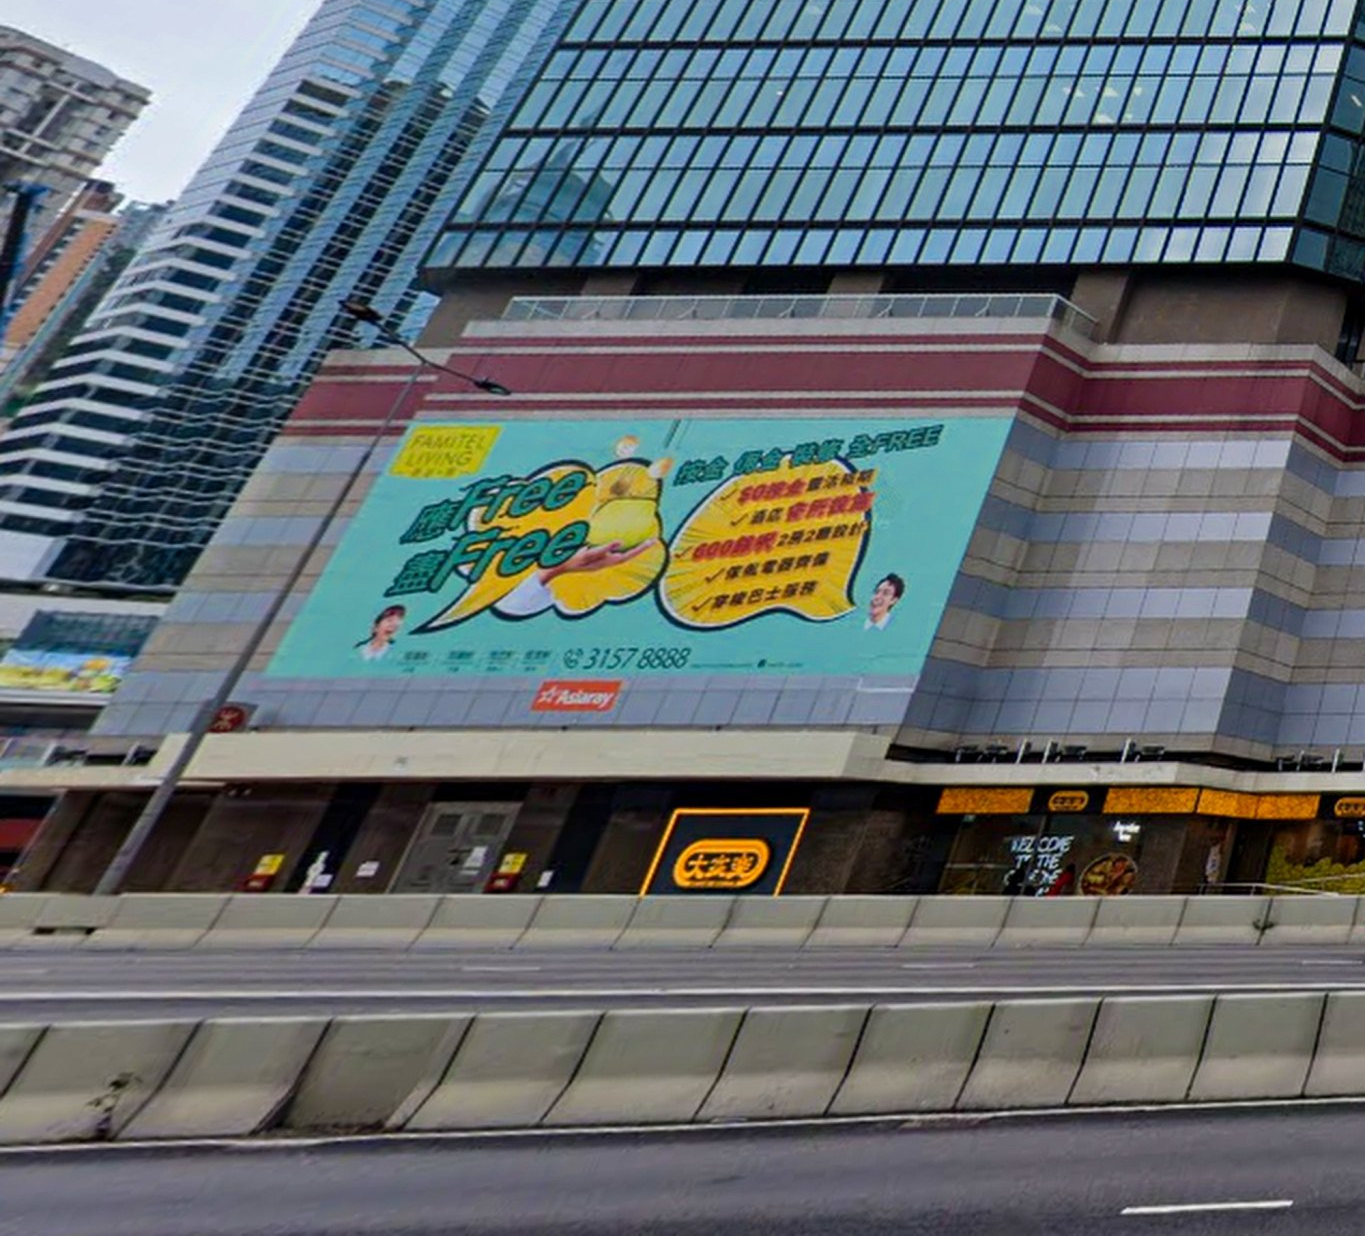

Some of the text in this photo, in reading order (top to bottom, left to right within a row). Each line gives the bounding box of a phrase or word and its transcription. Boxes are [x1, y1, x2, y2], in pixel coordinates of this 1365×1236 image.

[412, 433, 487, 450] FAMITEL
[406, 450, 474, 466] LIVING
[583, 647, 693, 670] 3157 8888
[557, 687, 615, 707] Asiaray
